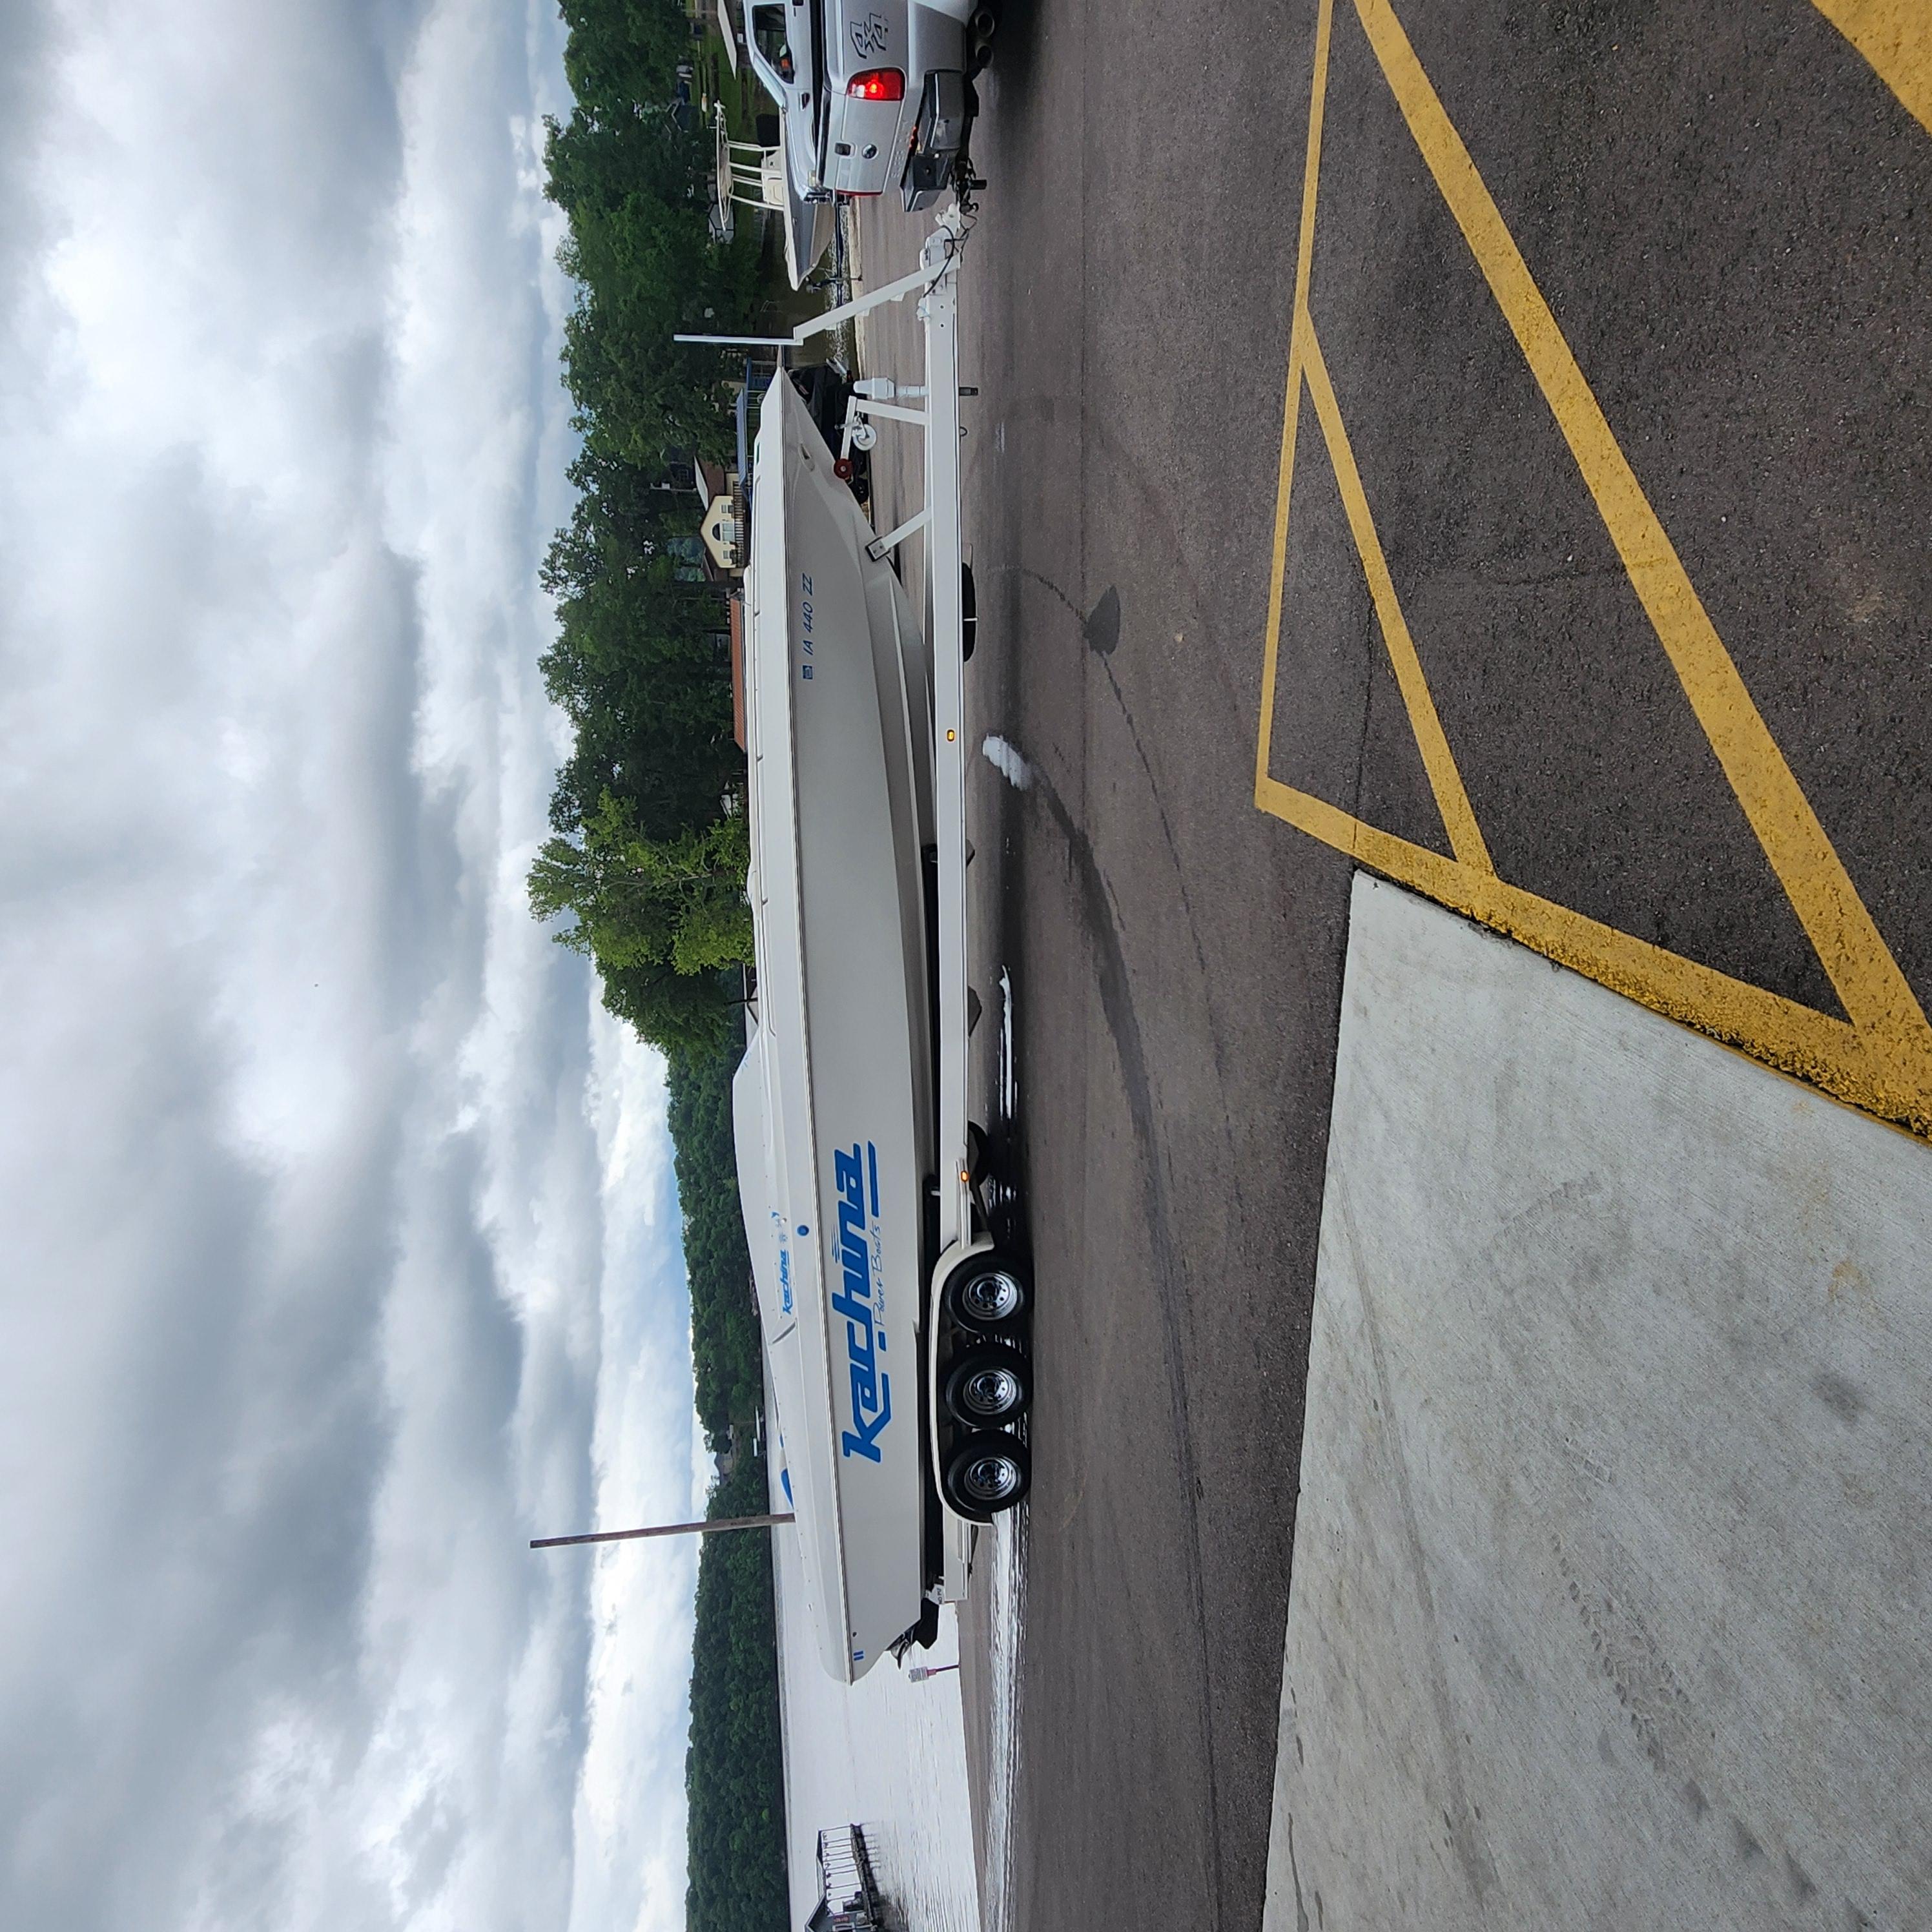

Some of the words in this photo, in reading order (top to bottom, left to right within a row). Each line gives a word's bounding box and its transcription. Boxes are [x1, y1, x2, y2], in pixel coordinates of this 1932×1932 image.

[802, 573, 812, 595] ZZ
[802, 601, 813, 633] 440
[803, 640, 813, 655] IA
[870, 1220, 883, 1273] Boats
[779, 1249, 793, 1315] Kachina
[830, 1140, 891, 1463] Kachina
[872, 1277, 887, 1328] Power
